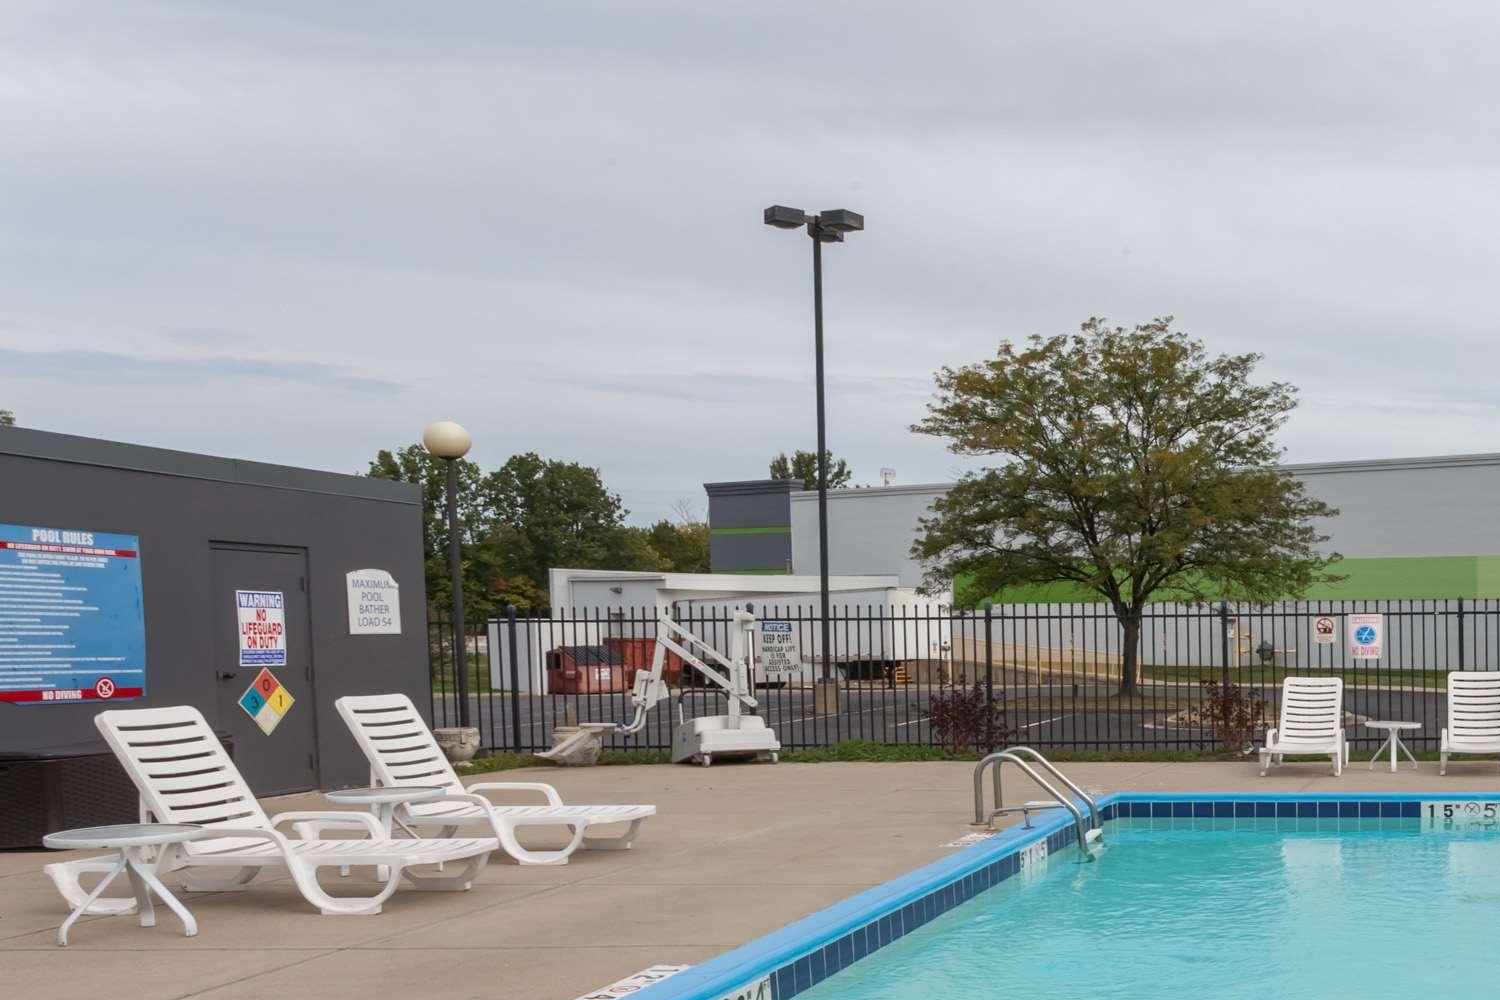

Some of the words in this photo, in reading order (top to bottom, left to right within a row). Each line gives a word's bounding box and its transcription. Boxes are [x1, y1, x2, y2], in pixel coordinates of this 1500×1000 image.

[32, 528, 61, 543] POOL
[62, 530, 94, 546] RULES
[239, 593, 281, 608] WARNING
[361, 591, 384, 602] POOL
[256, 608, 267, 622] NO
[359, 604, 390, 615] BATHER
[358, 616, 381, 627] LOAD
[242, 622, 282, 635] LIFEGUARD
[247, 636, 257, 648] ON
[259, 636, 278, 648] DUTY
[763, 633, 775, 644] KEEP
[262, 679, 271, 691] 0
[42, 691, 54, 700] NO
[55, 689, 82, 700] DIVING
[250, 696, 260, 709] 3
